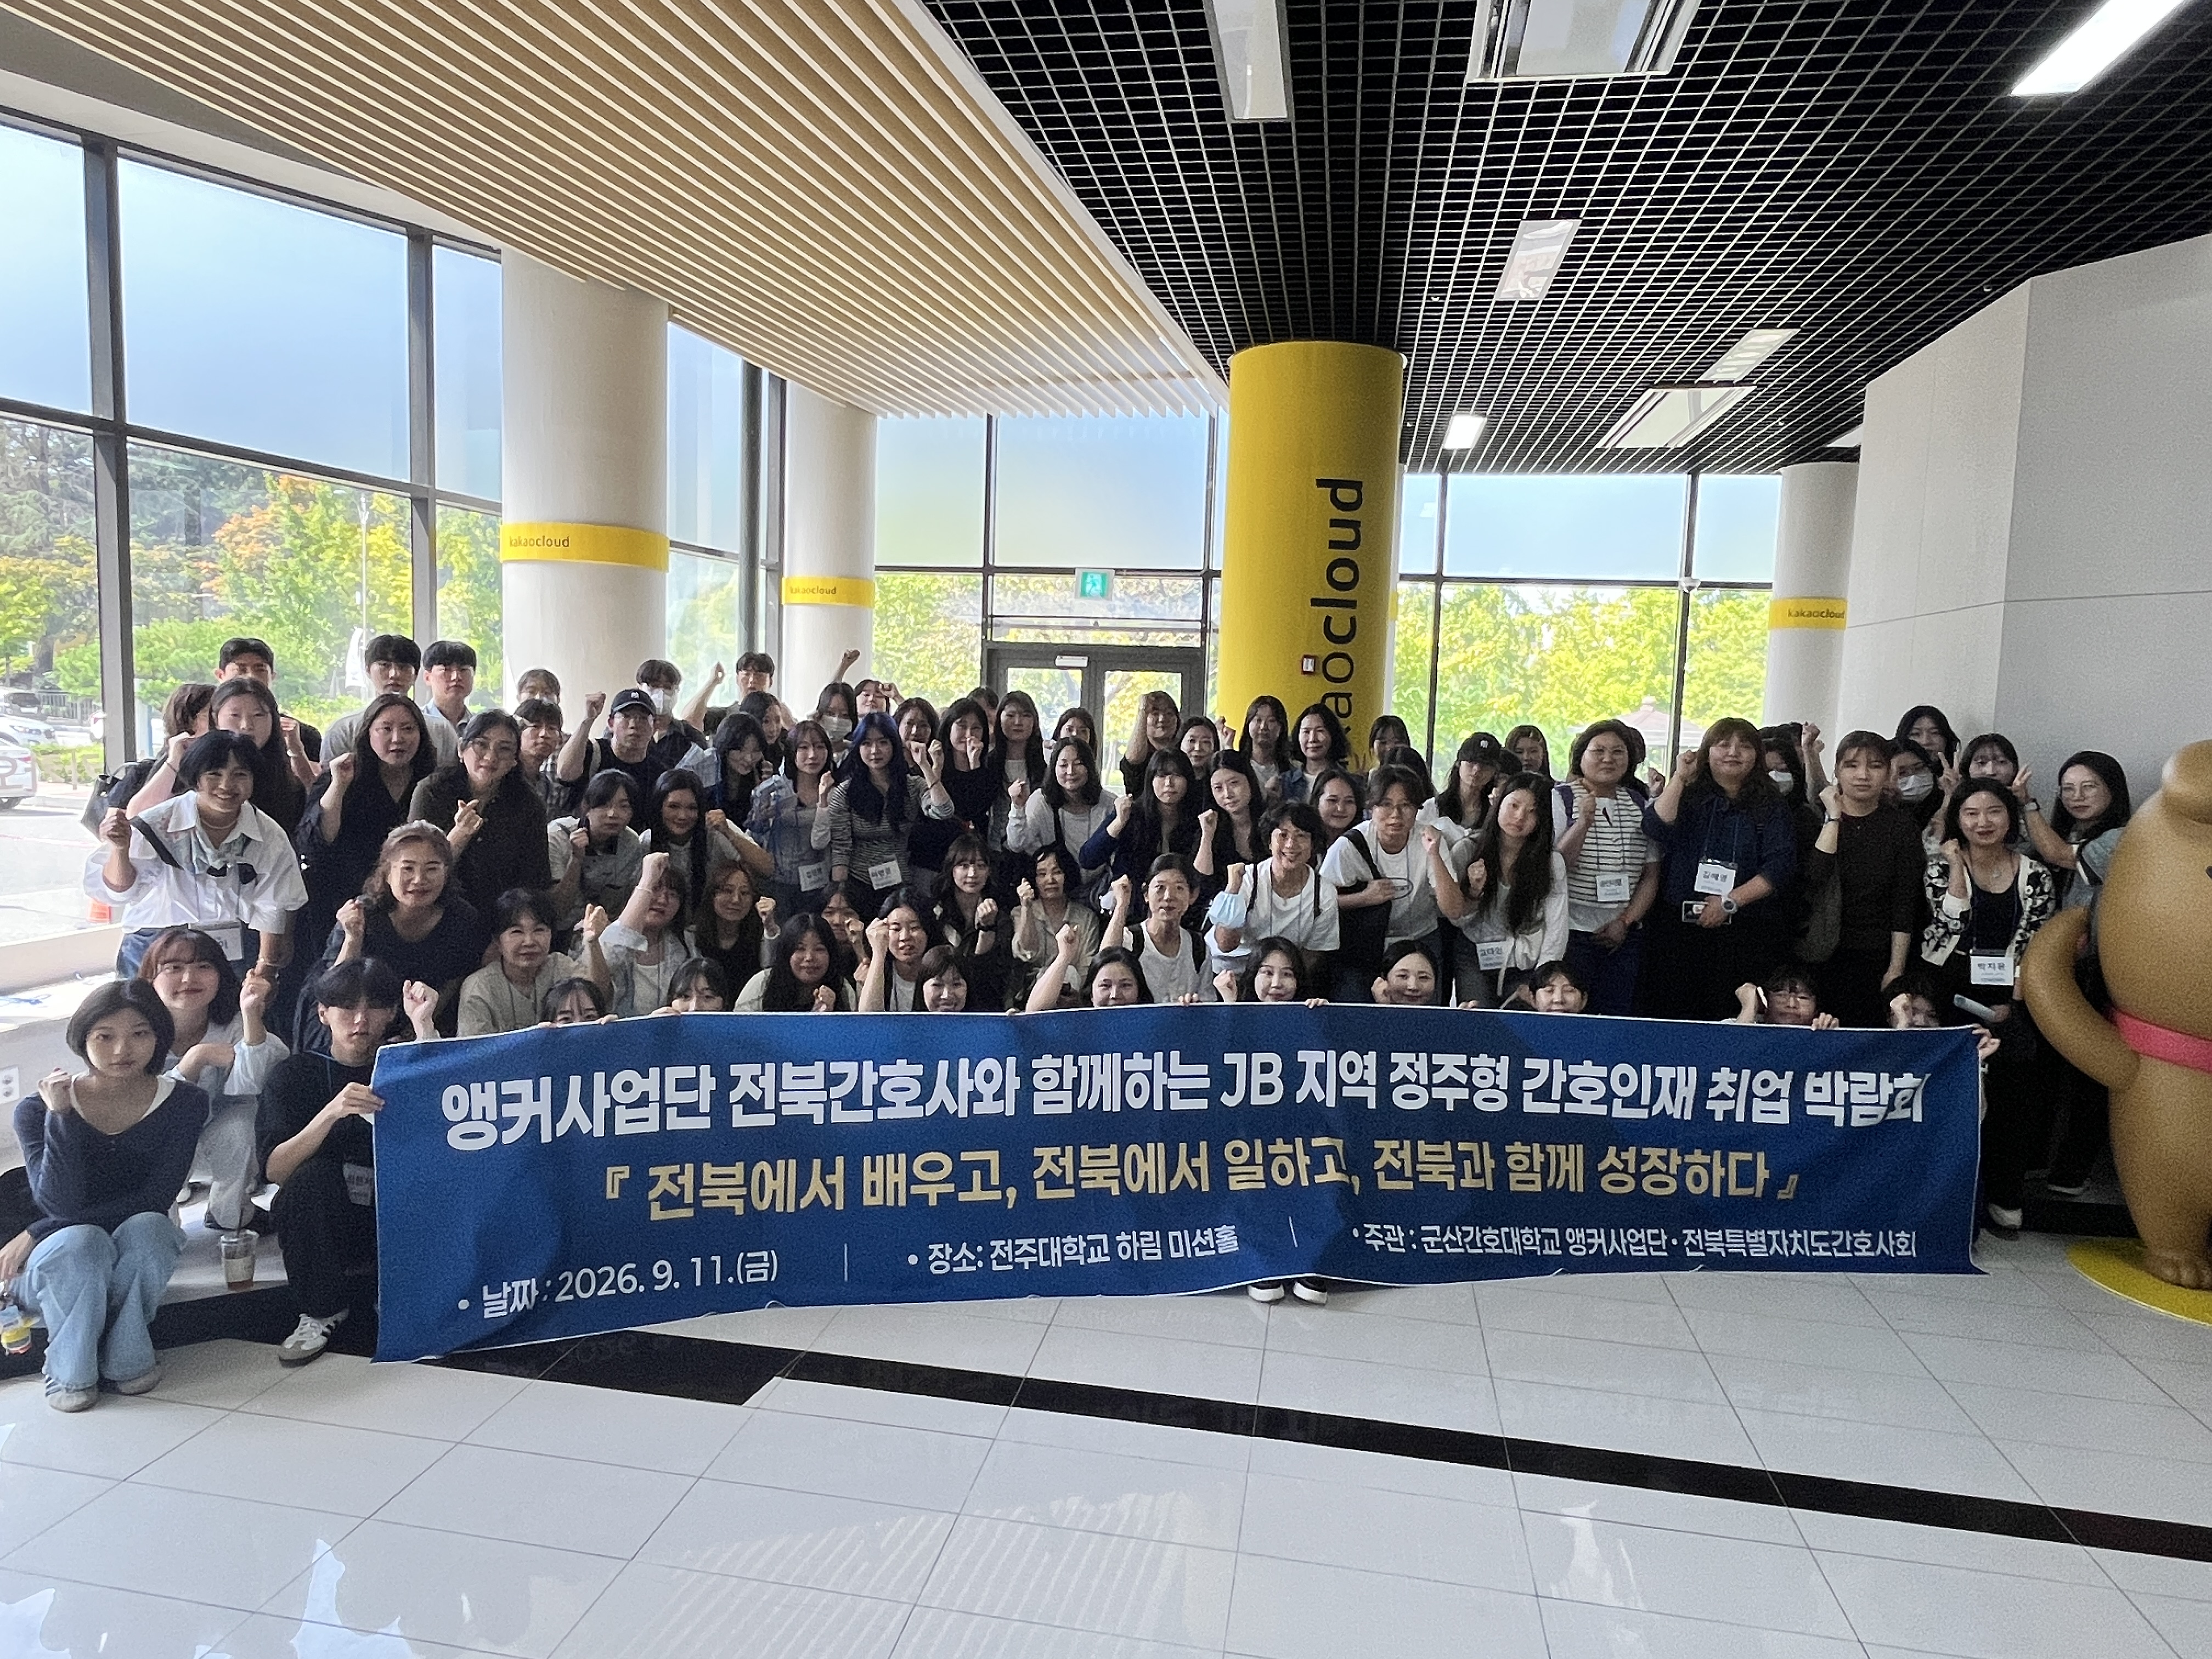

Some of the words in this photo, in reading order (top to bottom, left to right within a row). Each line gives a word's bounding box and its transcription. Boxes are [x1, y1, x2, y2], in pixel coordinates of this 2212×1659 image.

[509, 535, 570, 548] kakaocloud
[441, 1063, 716, 1152] 앵커사업단
[729, 1056, 1021, 1128] 전북간호사와
[1031, 1050, 1211, 1116] 함께하는
[1220, 1052, 1284, 1107] JB
[1295, 1049, 1378, 1109] 지역
[1389, 1052, 1511, 1111] 정주형
[1522, 1057, 1697, 1121] 간호인재
[1705, 1066, 1795, 1125] 취업
[1804, 1070, 1932, 1127] 박람회
[647, 1155, 845, 1221] 전북에서
[862, 1150, 1018, 1209] 배우고,
[1032, 1141, 1210, 1200] 전북에서
[1223, 1136, 1361, 1195] 일하고,
[1373, 1139, 1496, 1192] 전북과
[1505, 1141, 1585, 1194] 함께
[1597, 1146, 1770, 1198] 성장하다
[989, 1233, 1111, 1272] 전주대학교
[1115, 1229, 1163, 1262] 하림
[1167, 1223, 1240, 1259] 미션홀
[1420, 1225, 1563, 1256] 군산간호대학교
